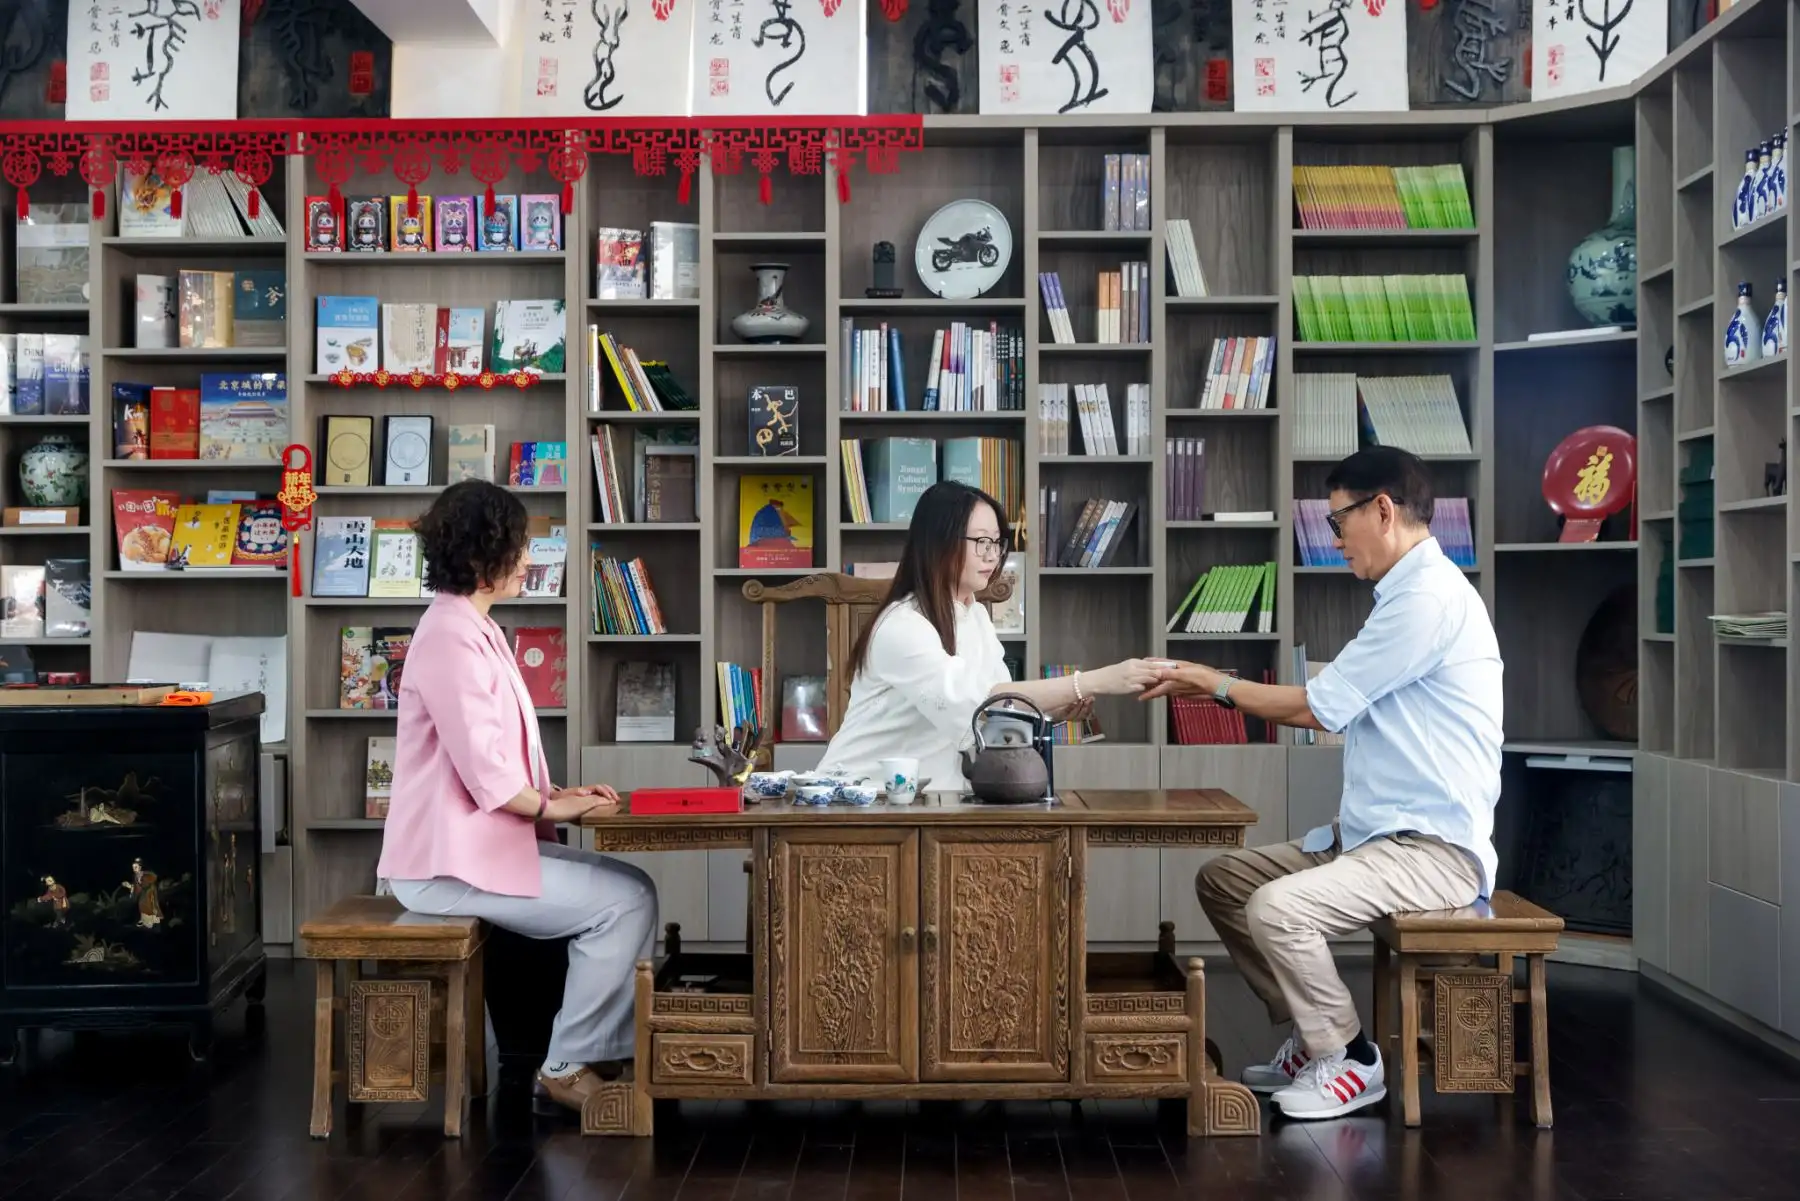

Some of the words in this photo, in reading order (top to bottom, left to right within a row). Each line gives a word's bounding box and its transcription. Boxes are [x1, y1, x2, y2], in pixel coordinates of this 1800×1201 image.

[1573, 453, 1614, 507] 福
[344, 520, 366, 569] 雪山大地
